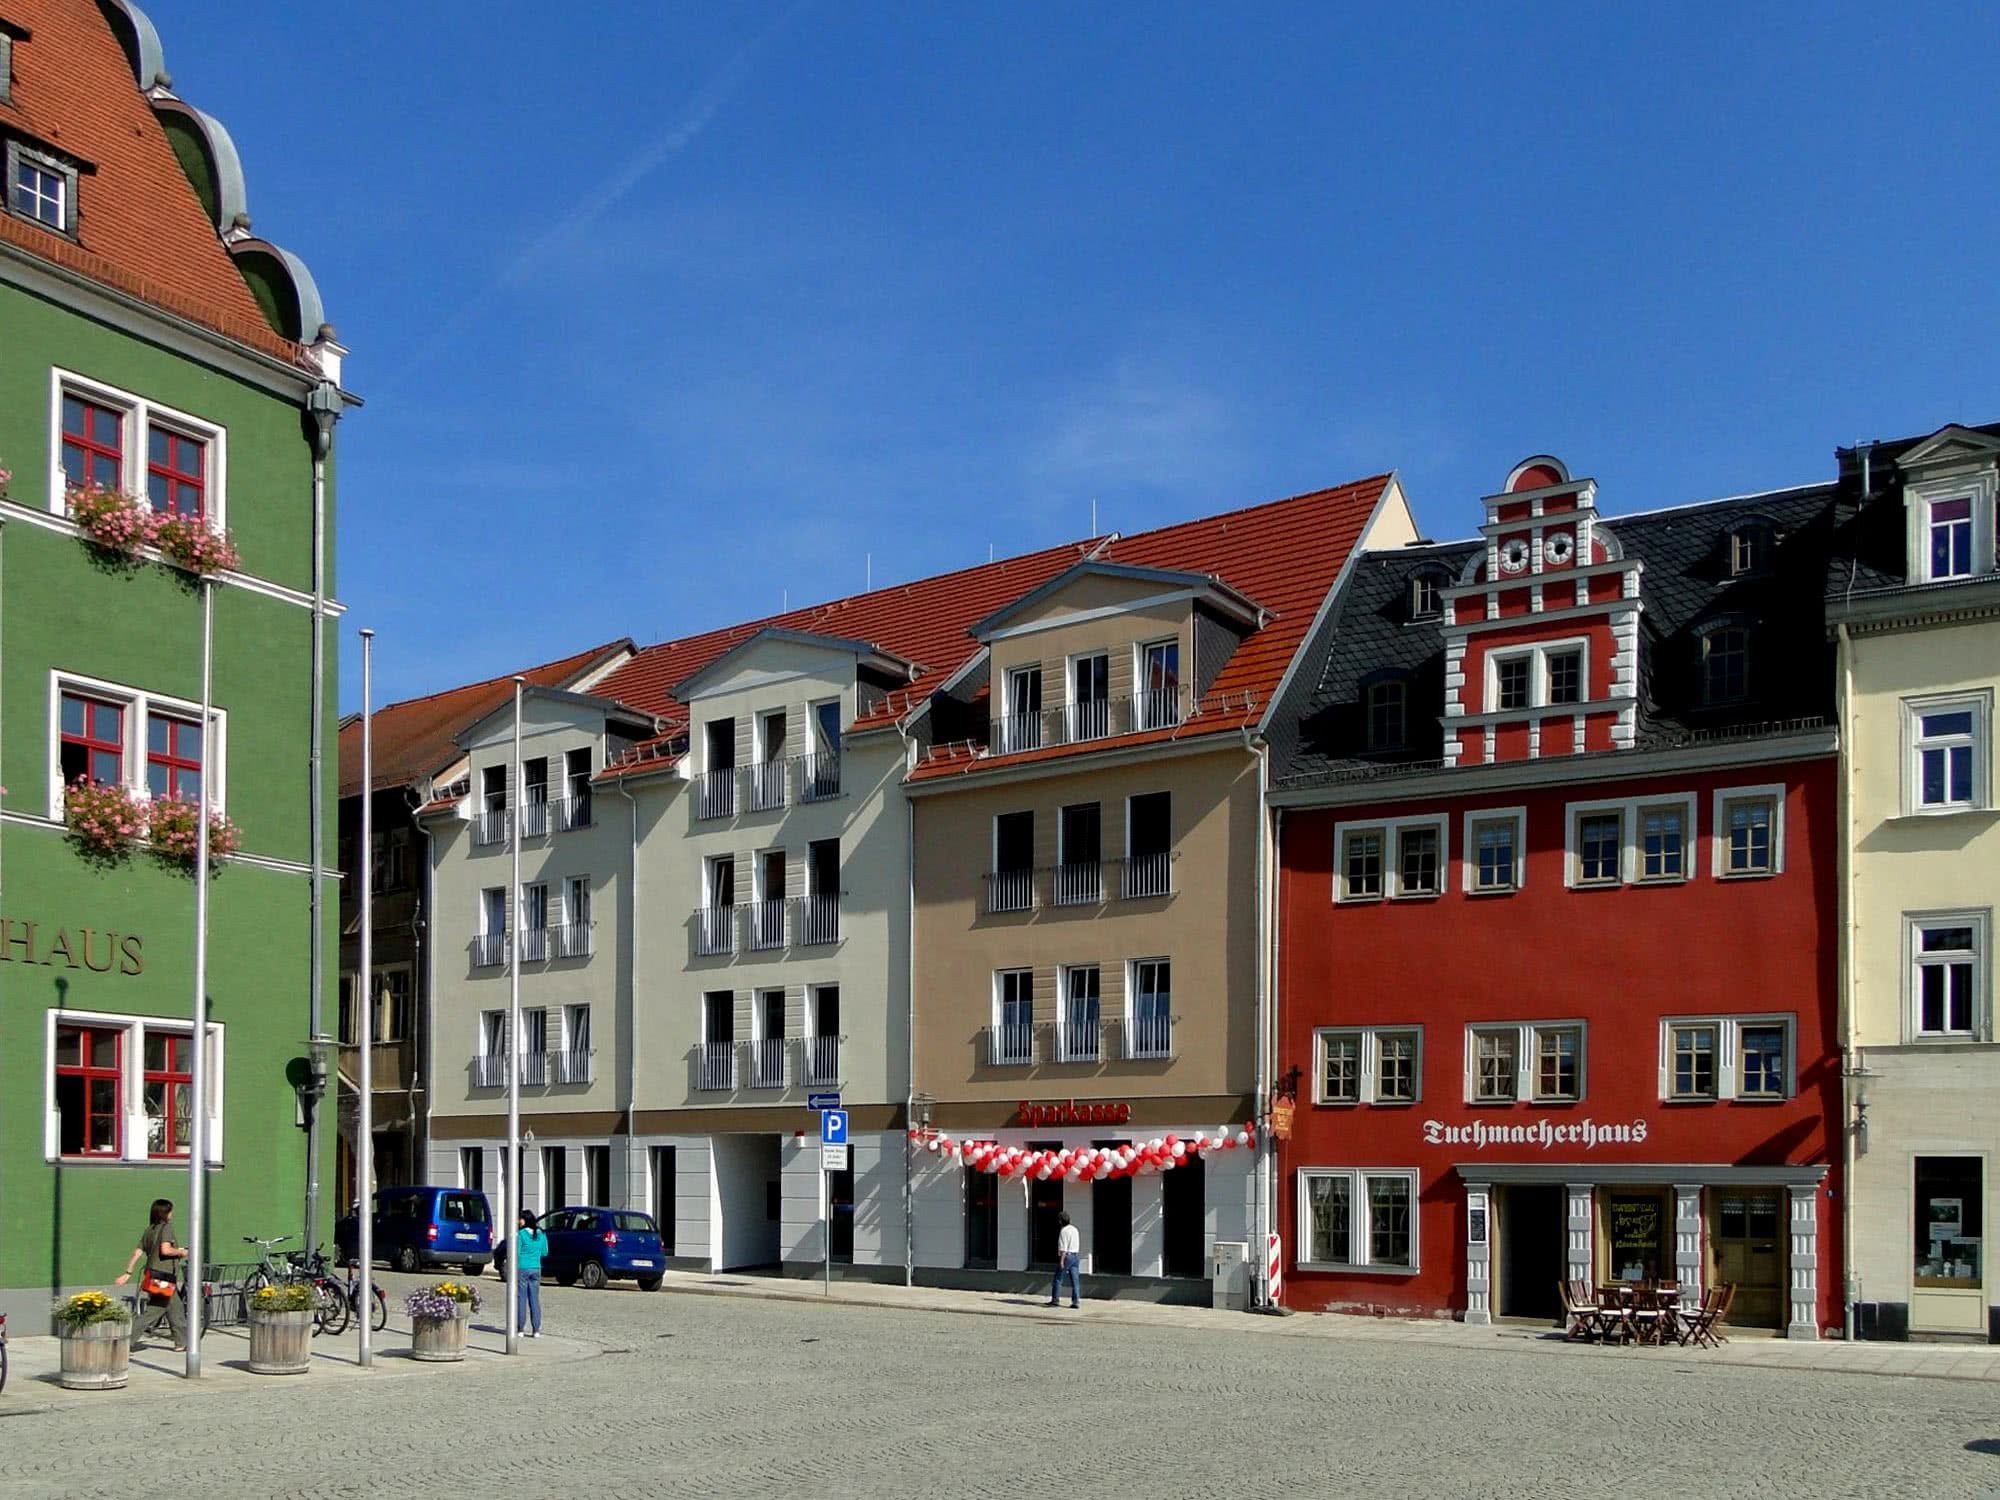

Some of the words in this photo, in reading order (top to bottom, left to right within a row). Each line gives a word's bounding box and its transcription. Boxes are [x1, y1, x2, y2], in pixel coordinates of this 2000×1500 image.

[0, 918, 144, 975] HAUS
[827, 1115, 842, 1140] P
[1018, 1099, 1131, 1128] Sparkasse
[1423, 1118, 1647, 1150] Tuchmacherhaus
